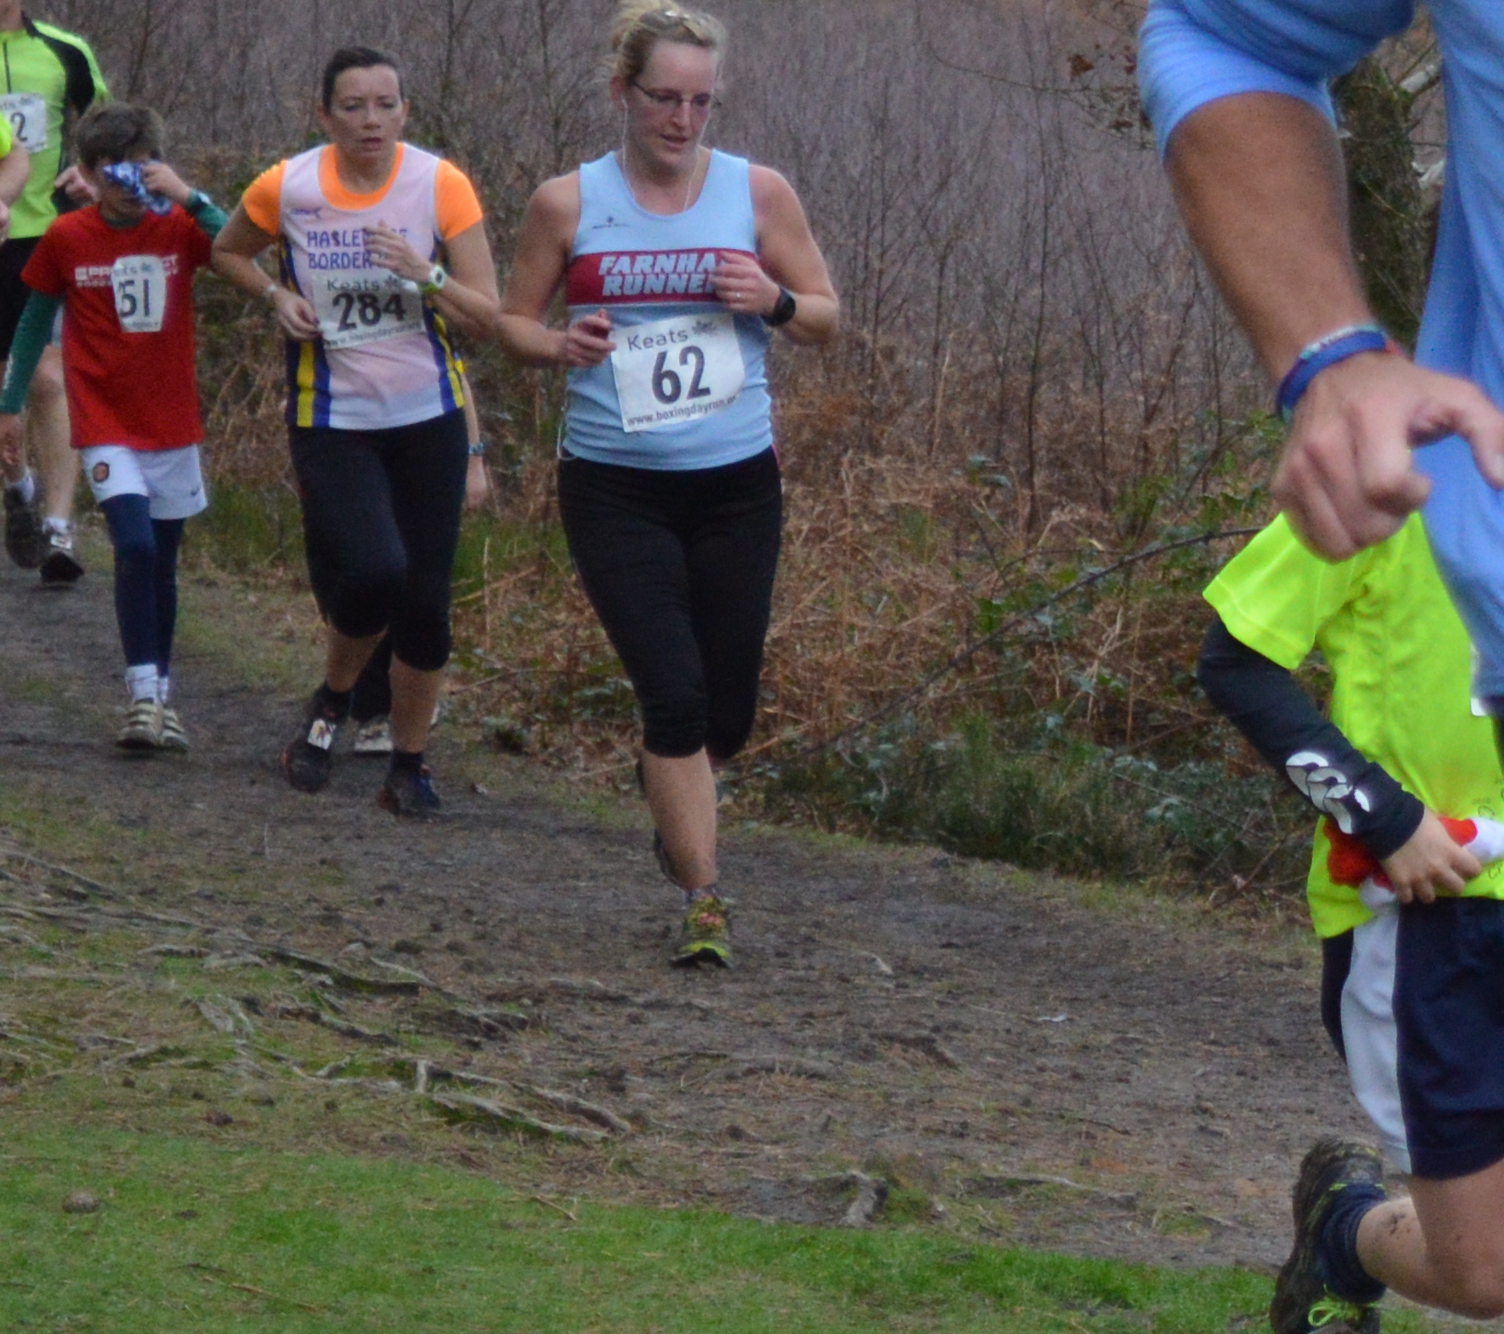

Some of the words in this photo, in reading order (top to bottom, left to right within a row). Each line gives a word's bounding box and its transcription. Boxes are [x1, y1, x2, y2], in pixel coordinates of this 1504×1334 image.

[598, 251, 727, 276] FARNHA
[327, 278, 381, 293] Keats
[332, 292, 407, 333] 284
[627, 328, 689, 352] Keats
[651, 345, 712, 405] 62
